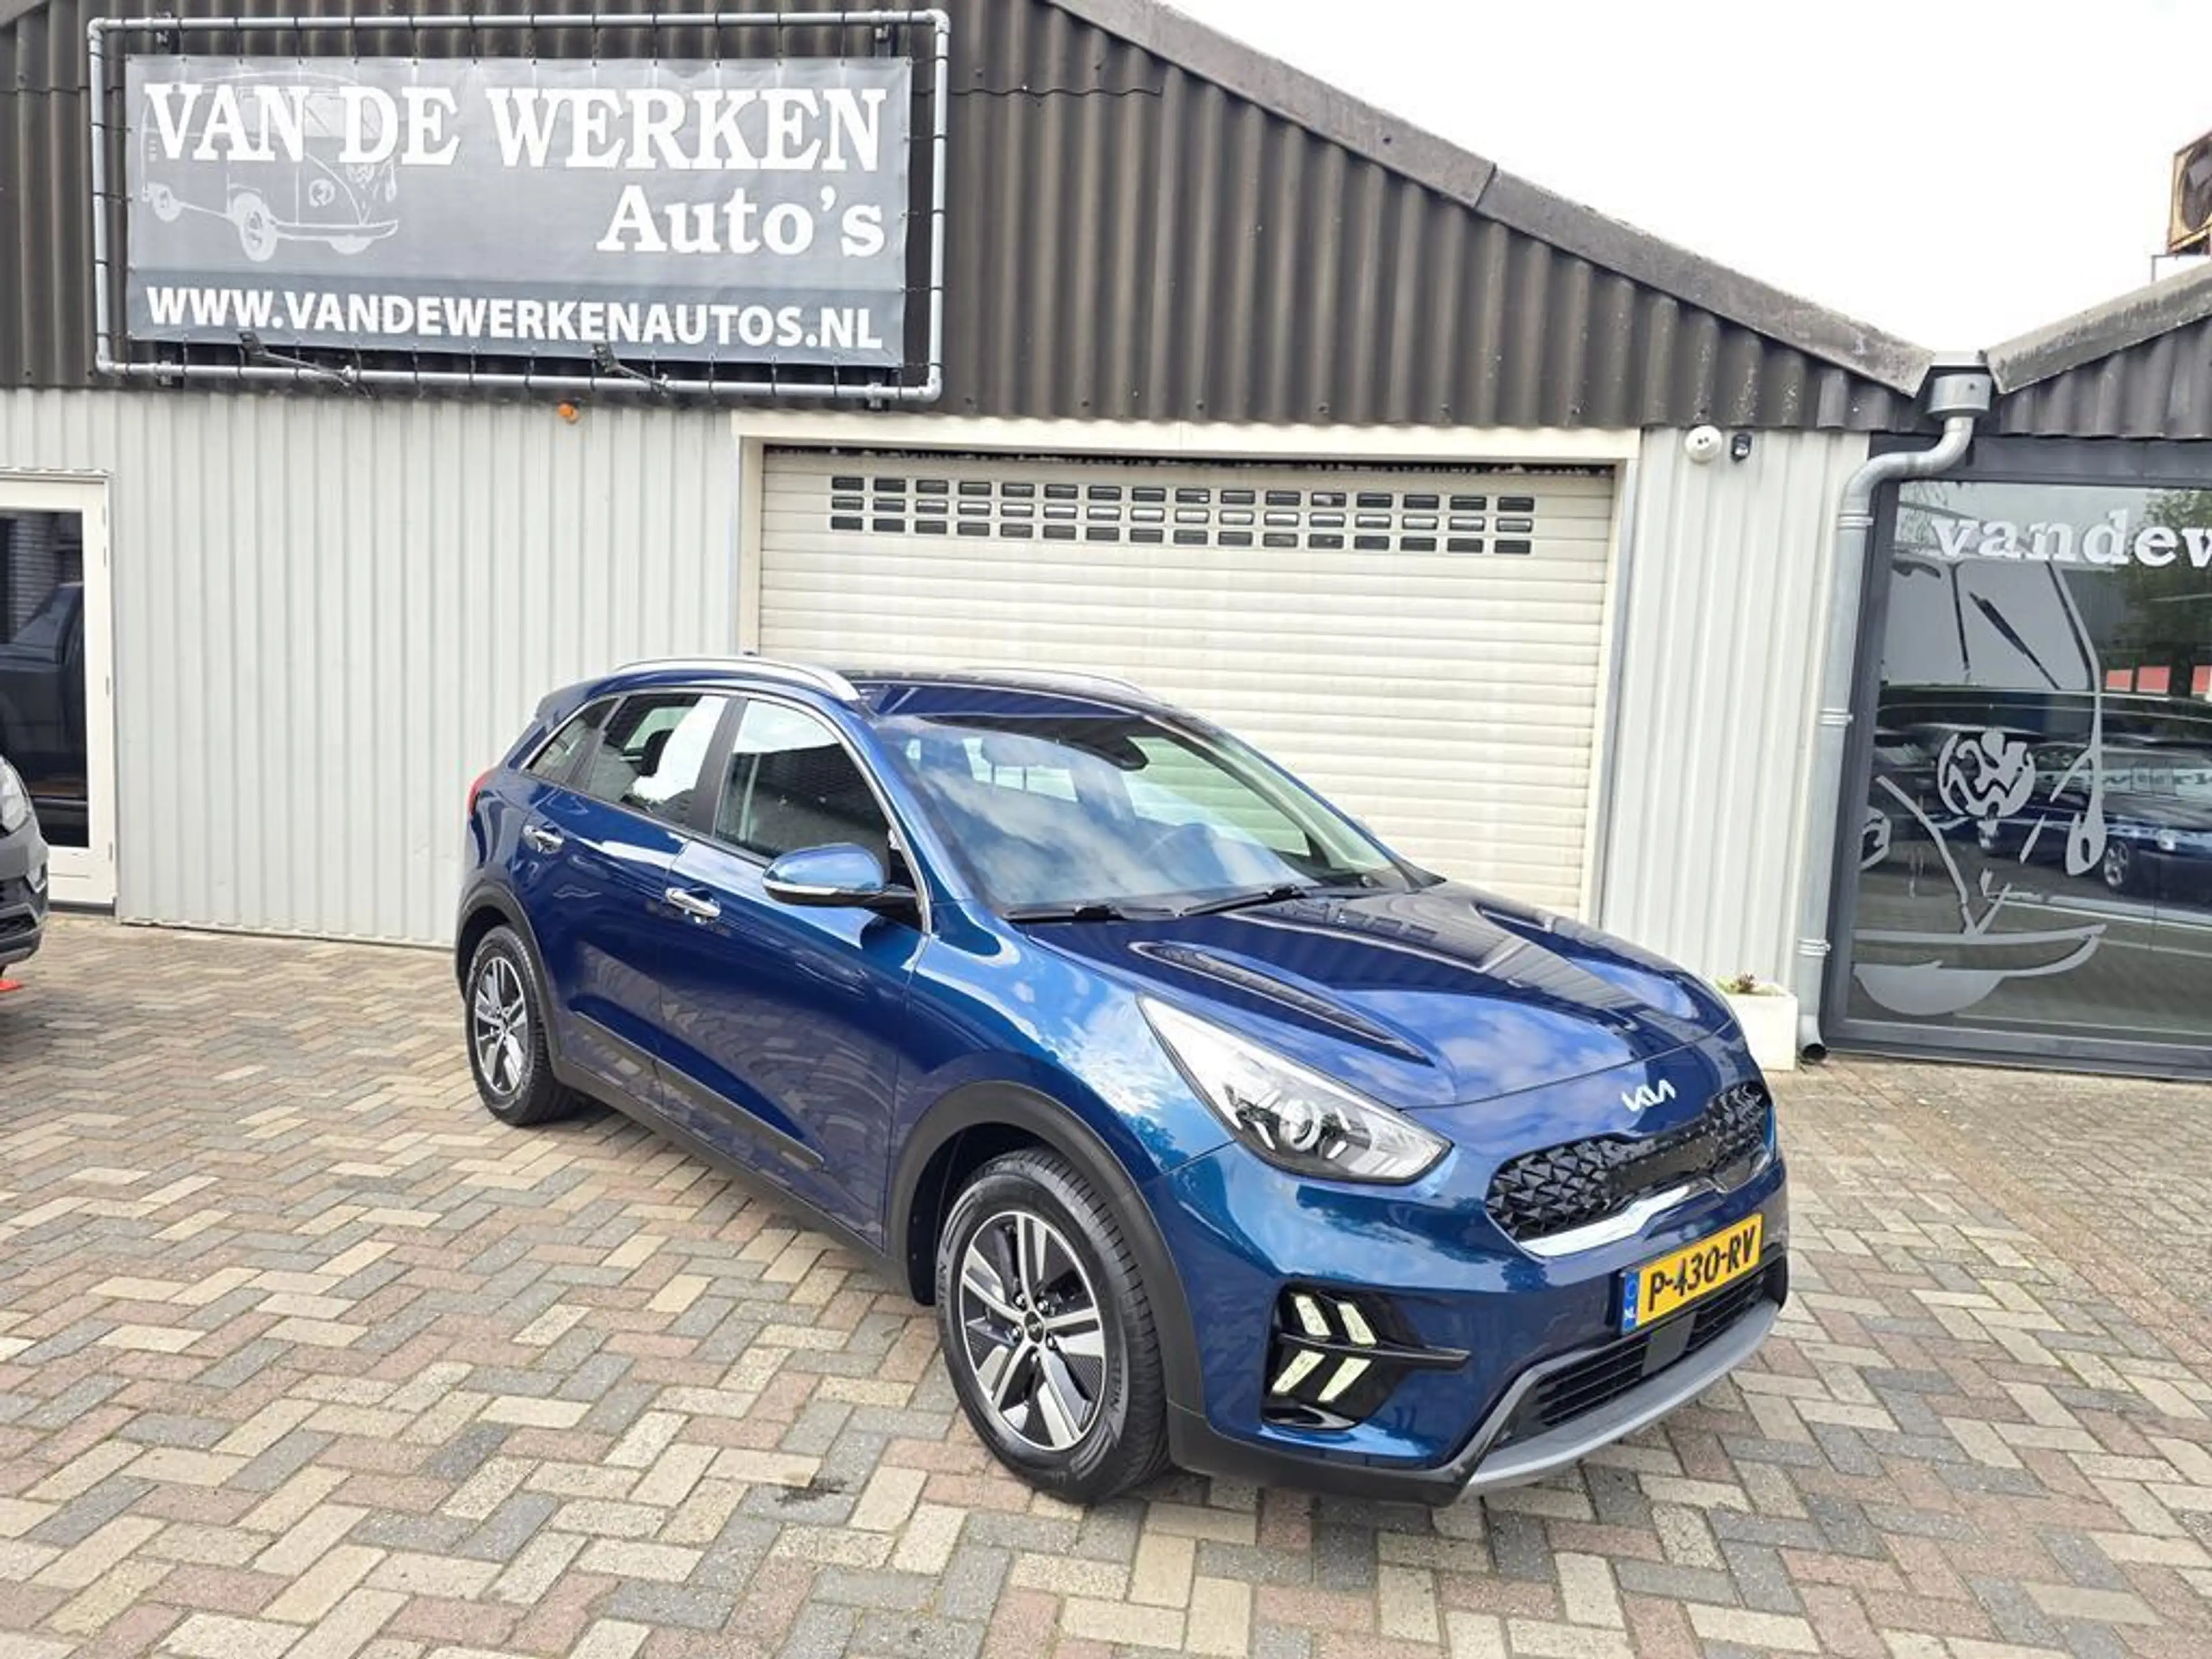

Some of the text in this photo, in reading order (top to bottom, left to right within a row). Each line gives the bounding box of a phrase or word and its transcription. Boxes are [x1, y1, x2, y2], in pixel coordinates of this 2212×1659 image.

[144, 83, 887, 171] VAN DE WERKEN
[596, 184, 885, 257] Auto's
[146, 286, 882, 349] WWW.VANDEWERKENAUTOS.NL
[1621, 1080, 1676, 1112] KIA
[1647, 1225, 1756, 1312] P-430-RV
